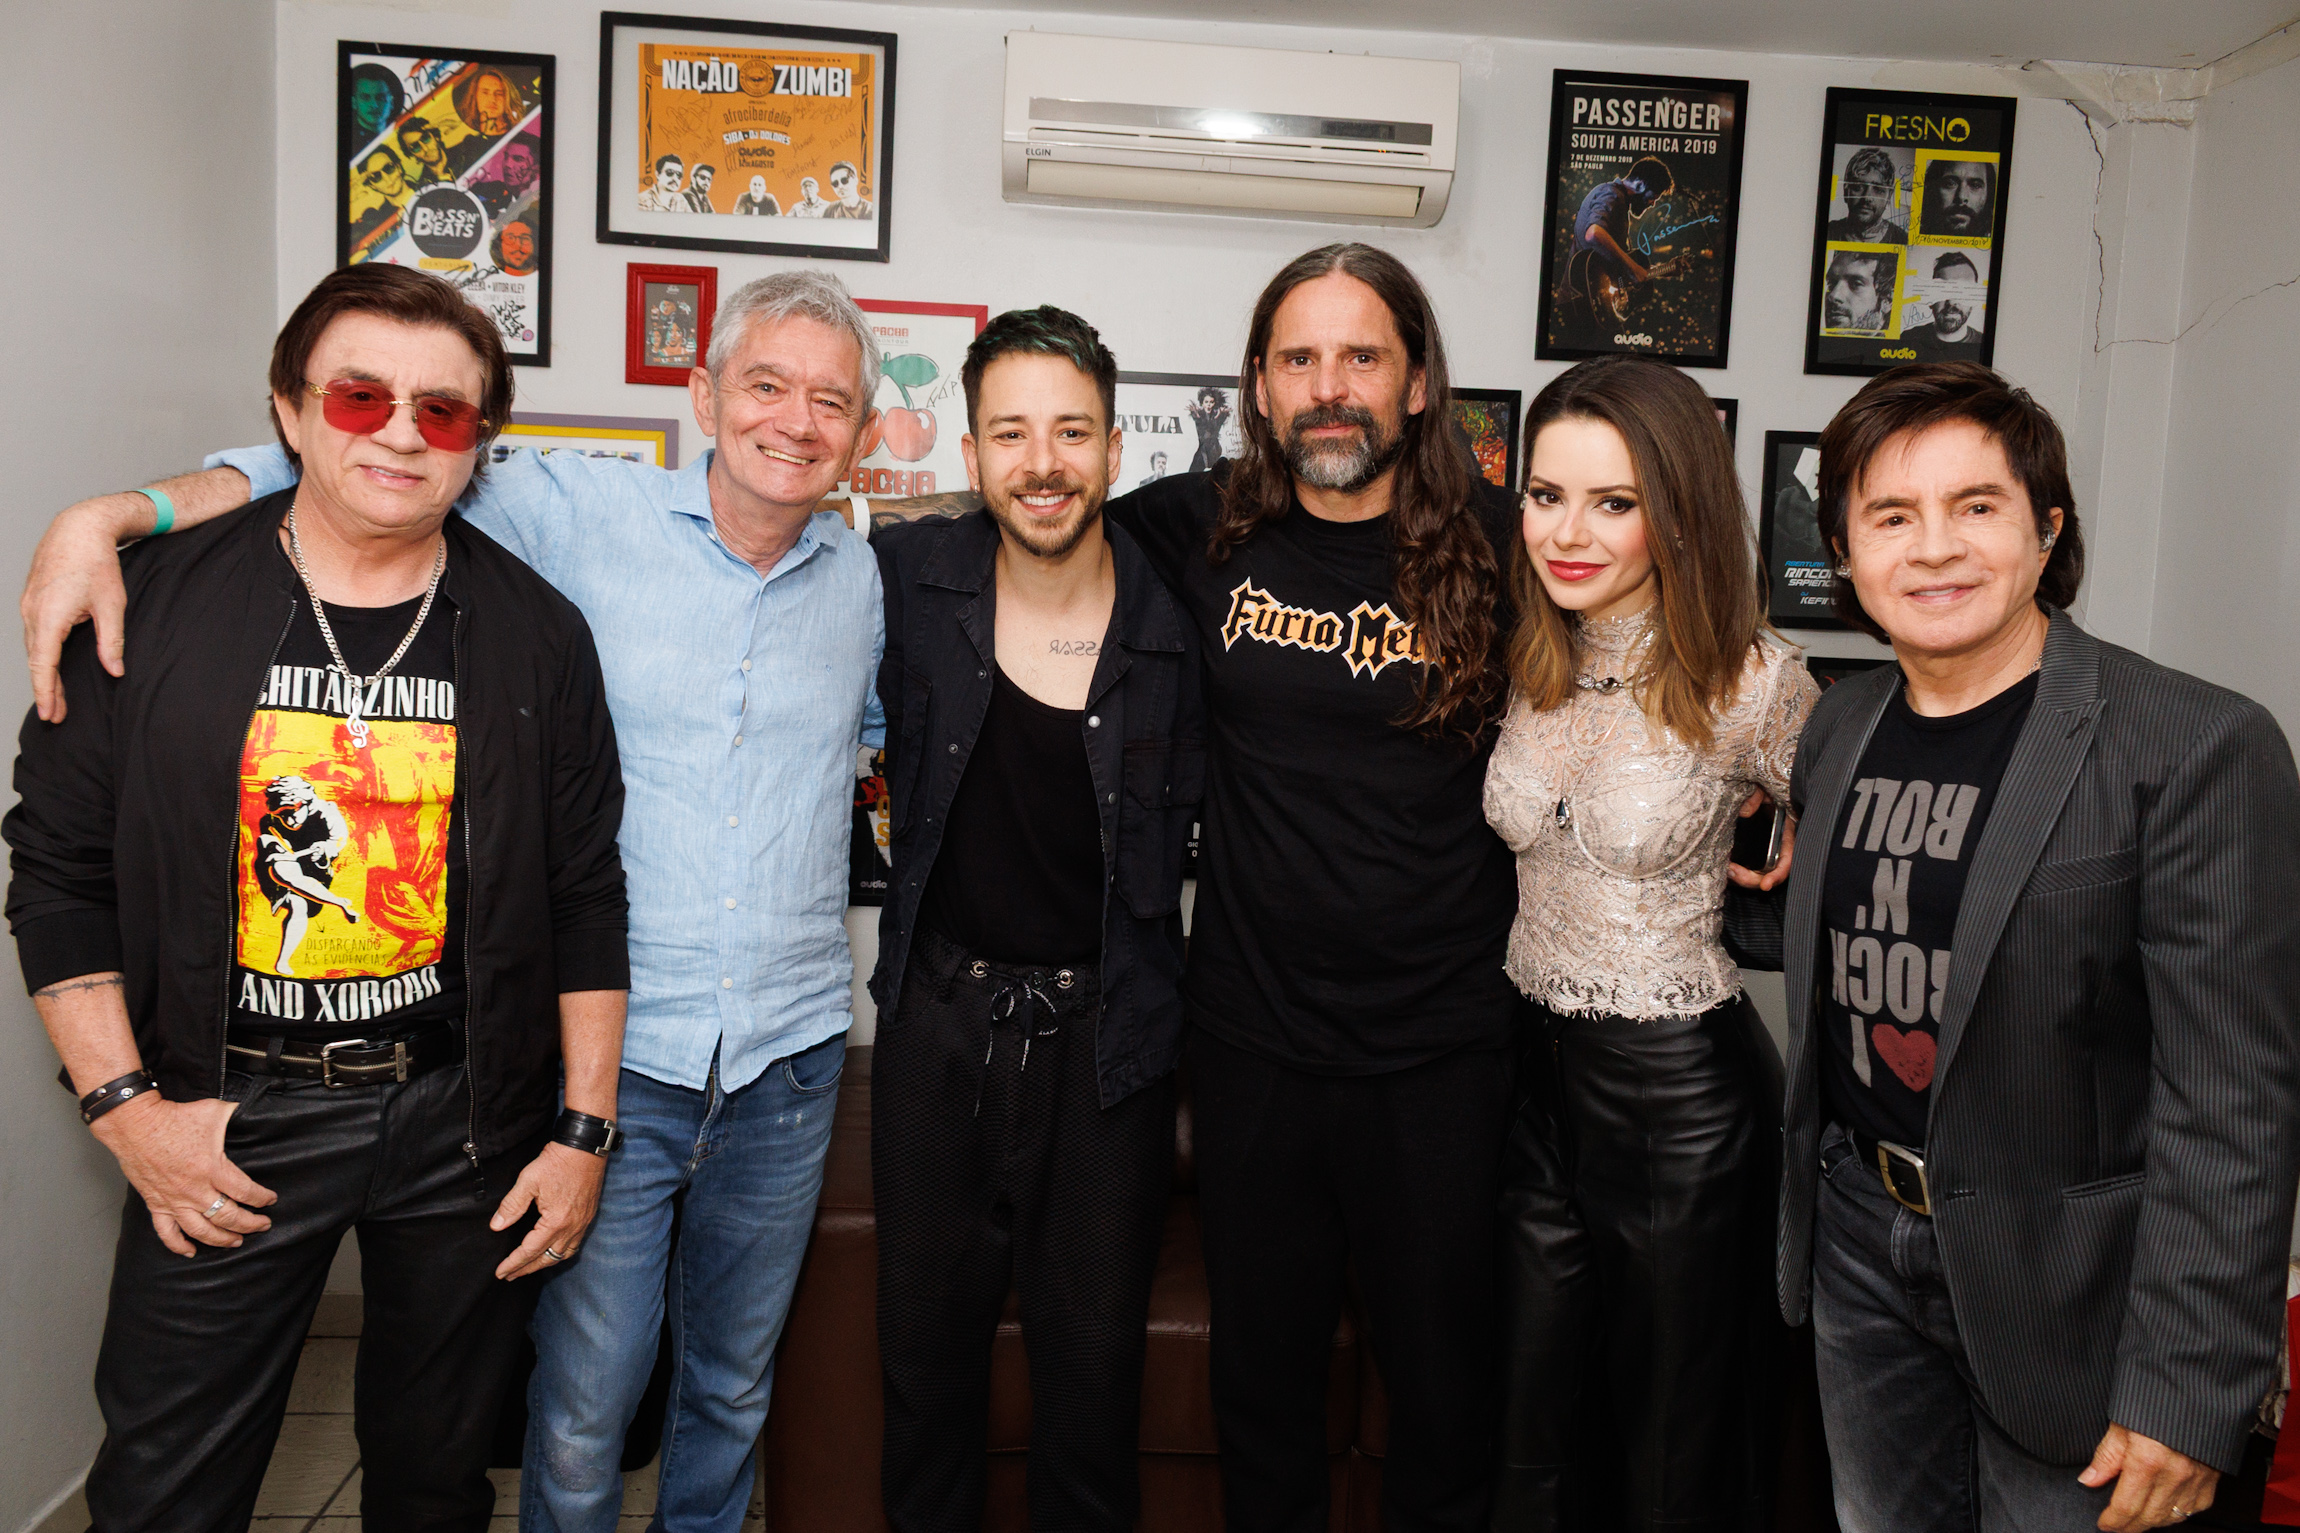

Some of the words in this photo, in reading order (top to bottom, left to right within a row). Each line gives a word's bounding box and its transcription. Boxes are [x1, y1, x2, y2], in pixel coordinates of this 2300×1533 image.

[661, 56, 739, 94] NAÇÃO
[773, 64, 852, 97] ZUMBI
[723, 106, 792, 127] afrociberdelia
[1572, 96, 1721, 131] PASSENGER
[1865, 113, 1970, 142] FRESNO
[723, 130, 745, 145] SIBA
[760, 130, 791, 145] DOLORES
[1571, 133, 1615, 150] SOUTH
[1619, 135, 1680, 153] AMERICA
[1684, 139, 1718, 155] 2019
[1025, 147, 1051, 156] ELGIN
[751, 159, 774, 168] AGOSTO
[1570, 161, 1582, 169] SÃO
[1584, 162, 1604, 170] PAULO
[1585, 154, 1617, 163] DEZEMBRO
[1618, 156, 1633, 164] 2019
[492, 282, 509, 292] VITOR
[510, 282, 525, 294] KLEY
[872, 326, 909, 337] PACHA
[1614, 333, 1653, 346] audio
[1880, 347, 1917, 360] audio
[1785, 560, 1825, 568] ABERTURA
[1788, 578, 1834, 588] SAPIENC
[1221, 577, 1344, 652] Furia
[1842, 777, 1980, 861] ROLL
[859, 880, 888, 889] audio
[306, 937, 381, 953] DISFARÇANDO
[304, 953, 318, 966] AS
[236, 972, 305, 1021] AND
